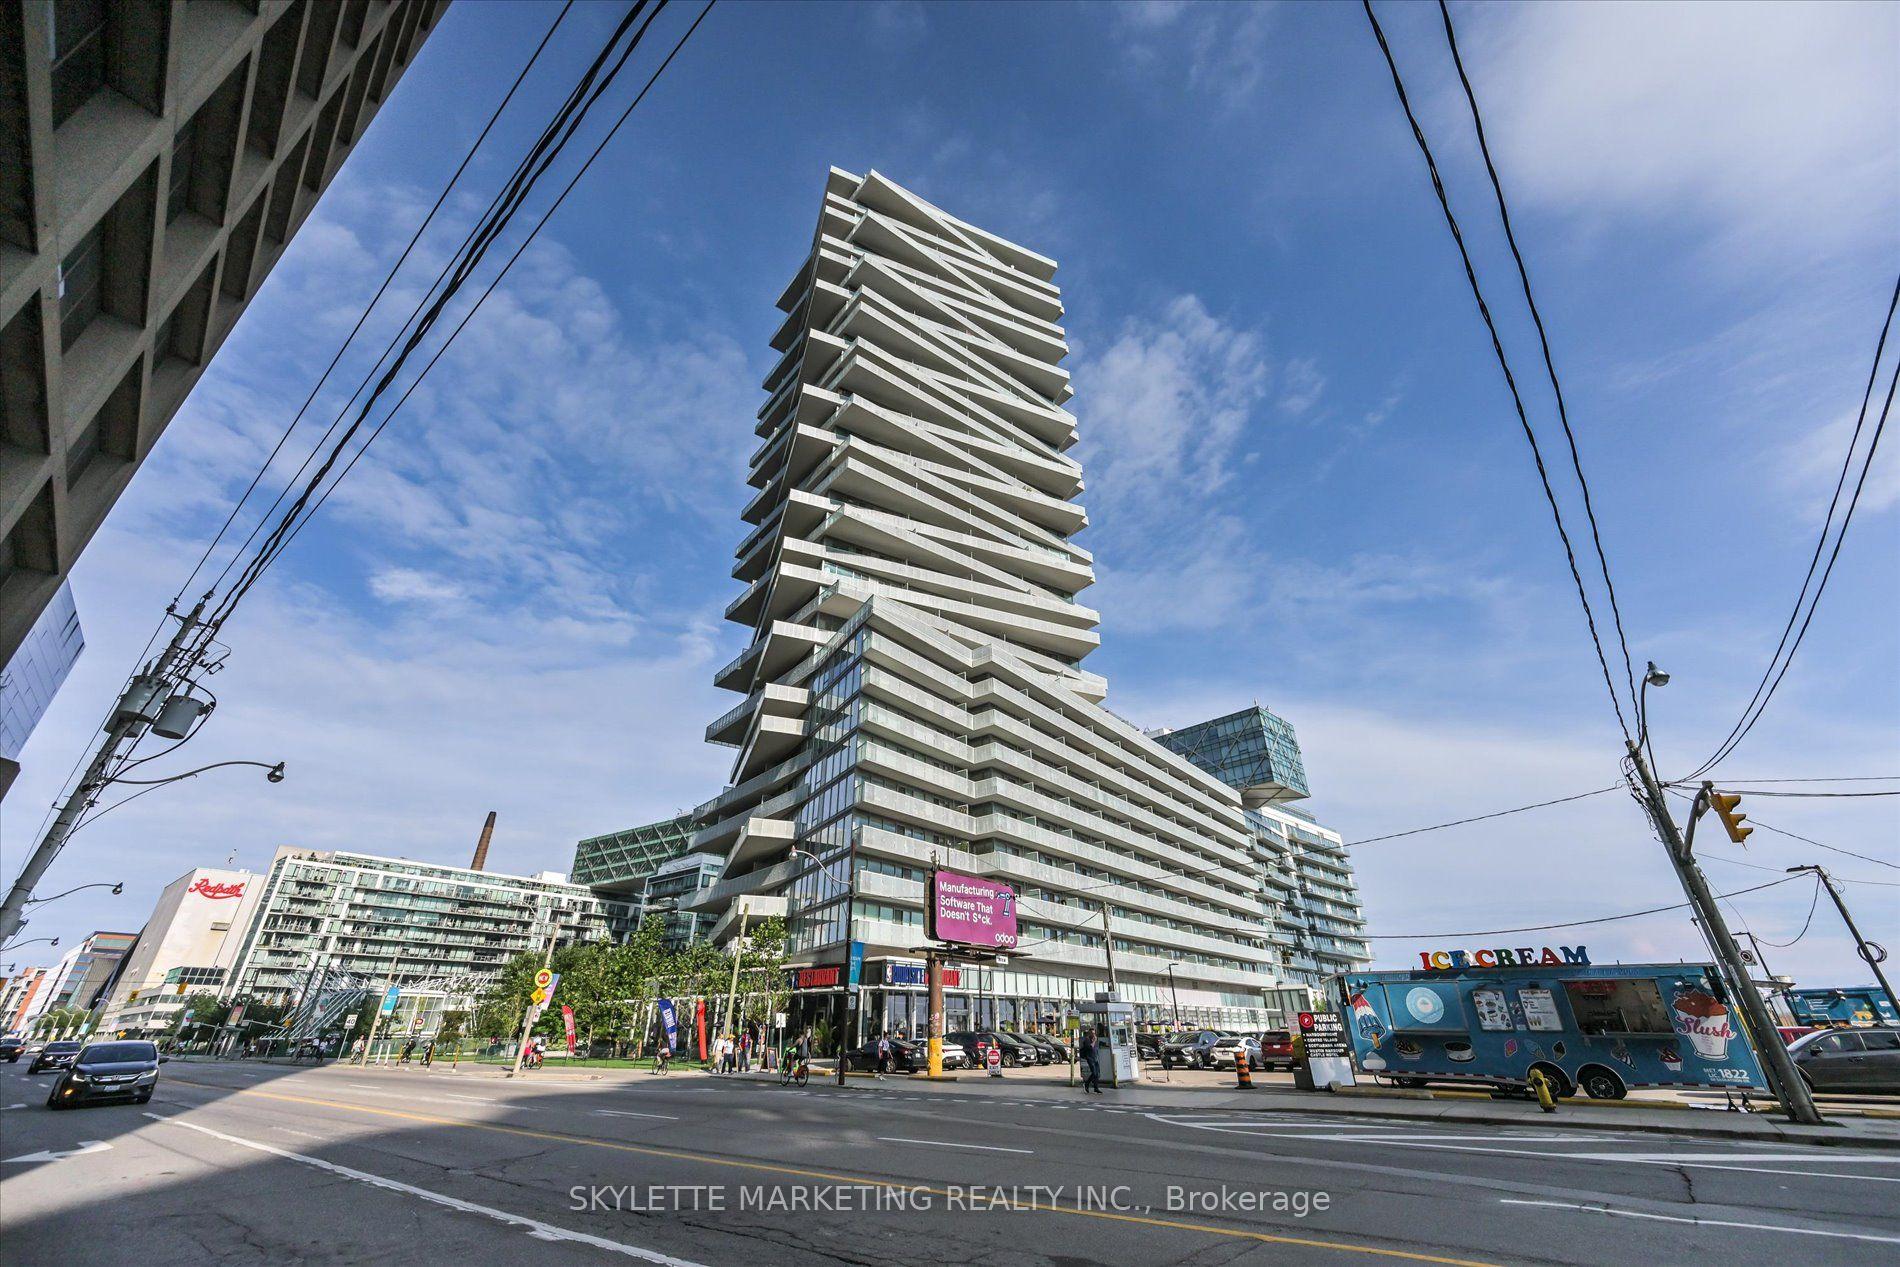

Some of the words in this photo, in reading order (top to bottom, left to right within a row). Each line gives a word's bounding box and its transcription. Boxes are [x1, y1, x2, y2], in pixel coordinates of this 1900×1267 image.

[188, 878, 245, 899] Redpath
[939, 881, 995, 900] Manufacturing
[940, 895, 976, 911] Software
[977, 902, 993, 914] That
[940, 907, 970, 922] Doesn't
[994, 932, 1015, 944] odoo
[1475, 945, 1592, 968] CREAM
[1313, 1014, 1338, 1022] PUBLIC
[1313, 1023, 1343, 1031] PARKING
[1675, 1017, 1736, 1039] Slush
[1718, 1068, 1750, 1079] 1822
